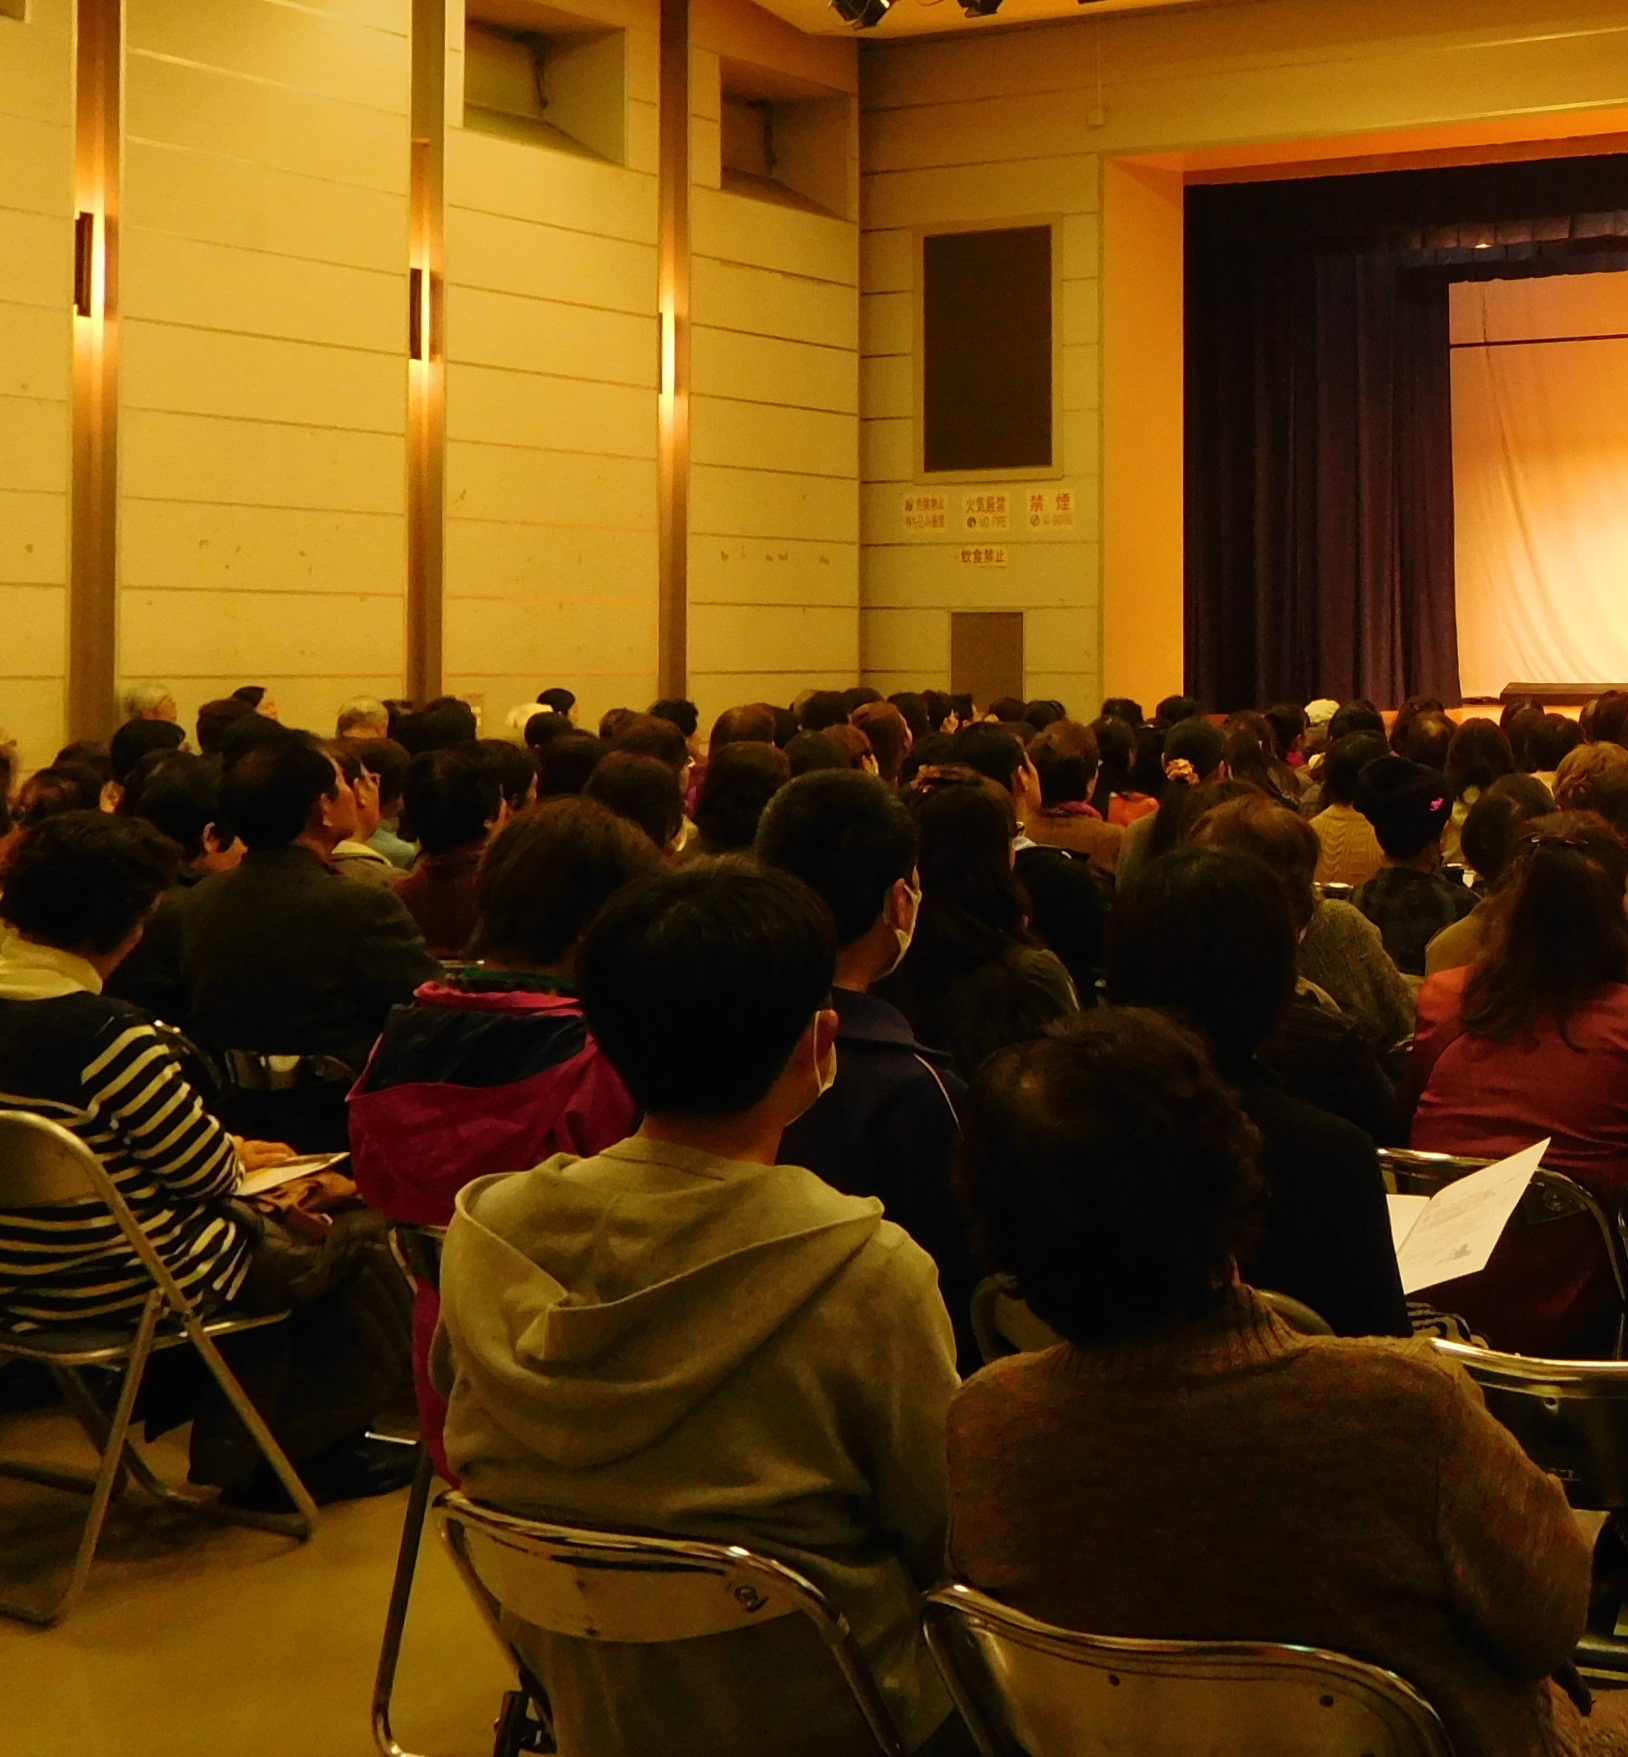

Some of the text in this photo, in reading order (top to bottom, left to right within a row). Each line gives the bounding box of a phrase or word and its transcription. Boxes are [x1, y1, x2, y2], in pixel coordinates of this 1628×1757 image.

[1029, 493, 1071, 512] 禁煙
[961, 548, 1005, 564] 飲食禁止
